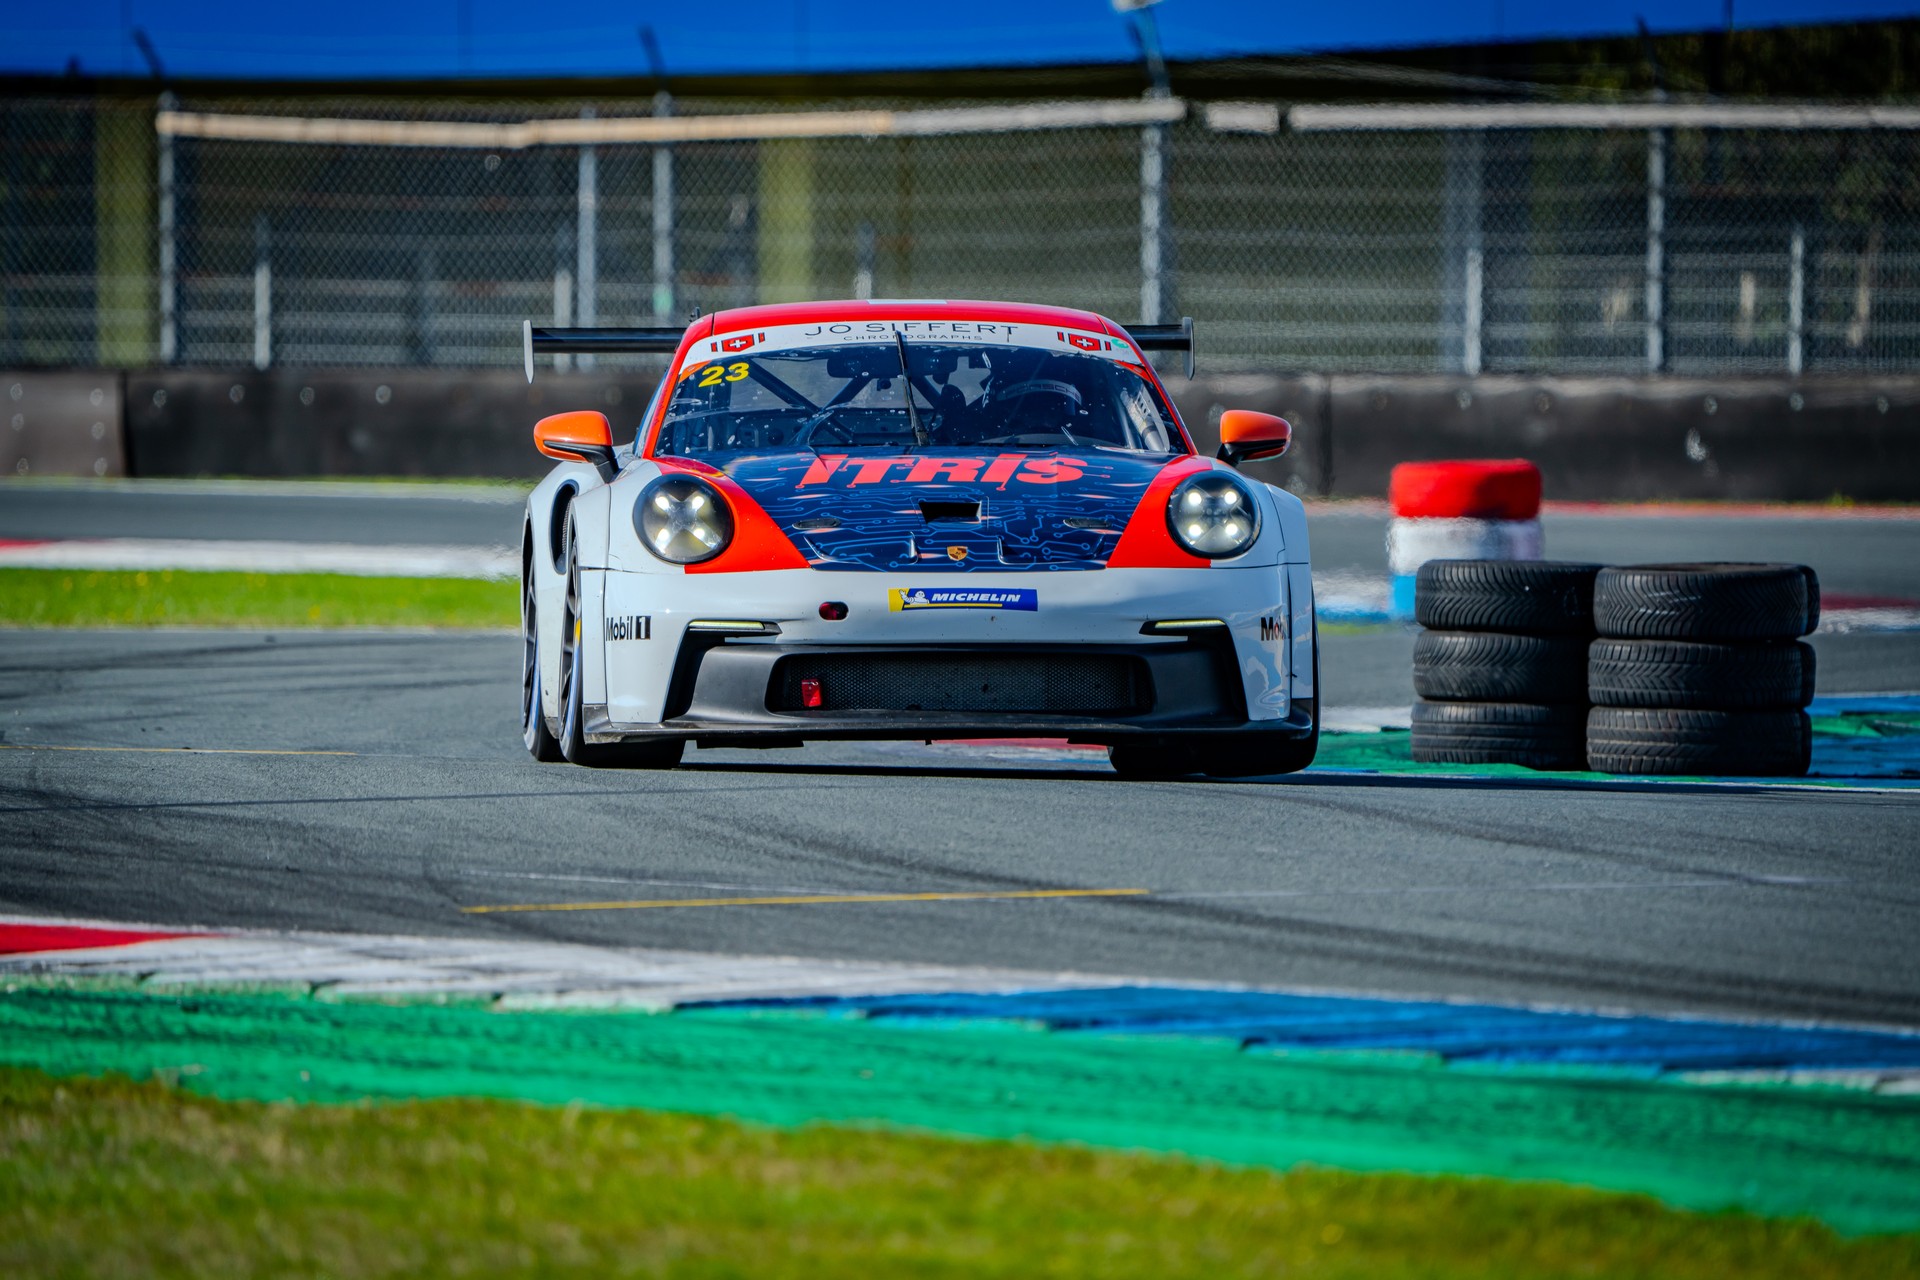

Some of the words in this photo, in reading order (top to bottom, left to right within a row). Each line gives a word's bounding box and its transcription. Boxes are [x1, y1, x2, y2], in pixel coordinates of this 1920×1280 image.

[805, 324, 852, 336] JO
[866, 322, 1018, 335] SIFFERT
[698, 362, 749, 388] 23
[931, 592, 1021, 603] MICHELIN
[605, 615, 633, 641] Mobil
